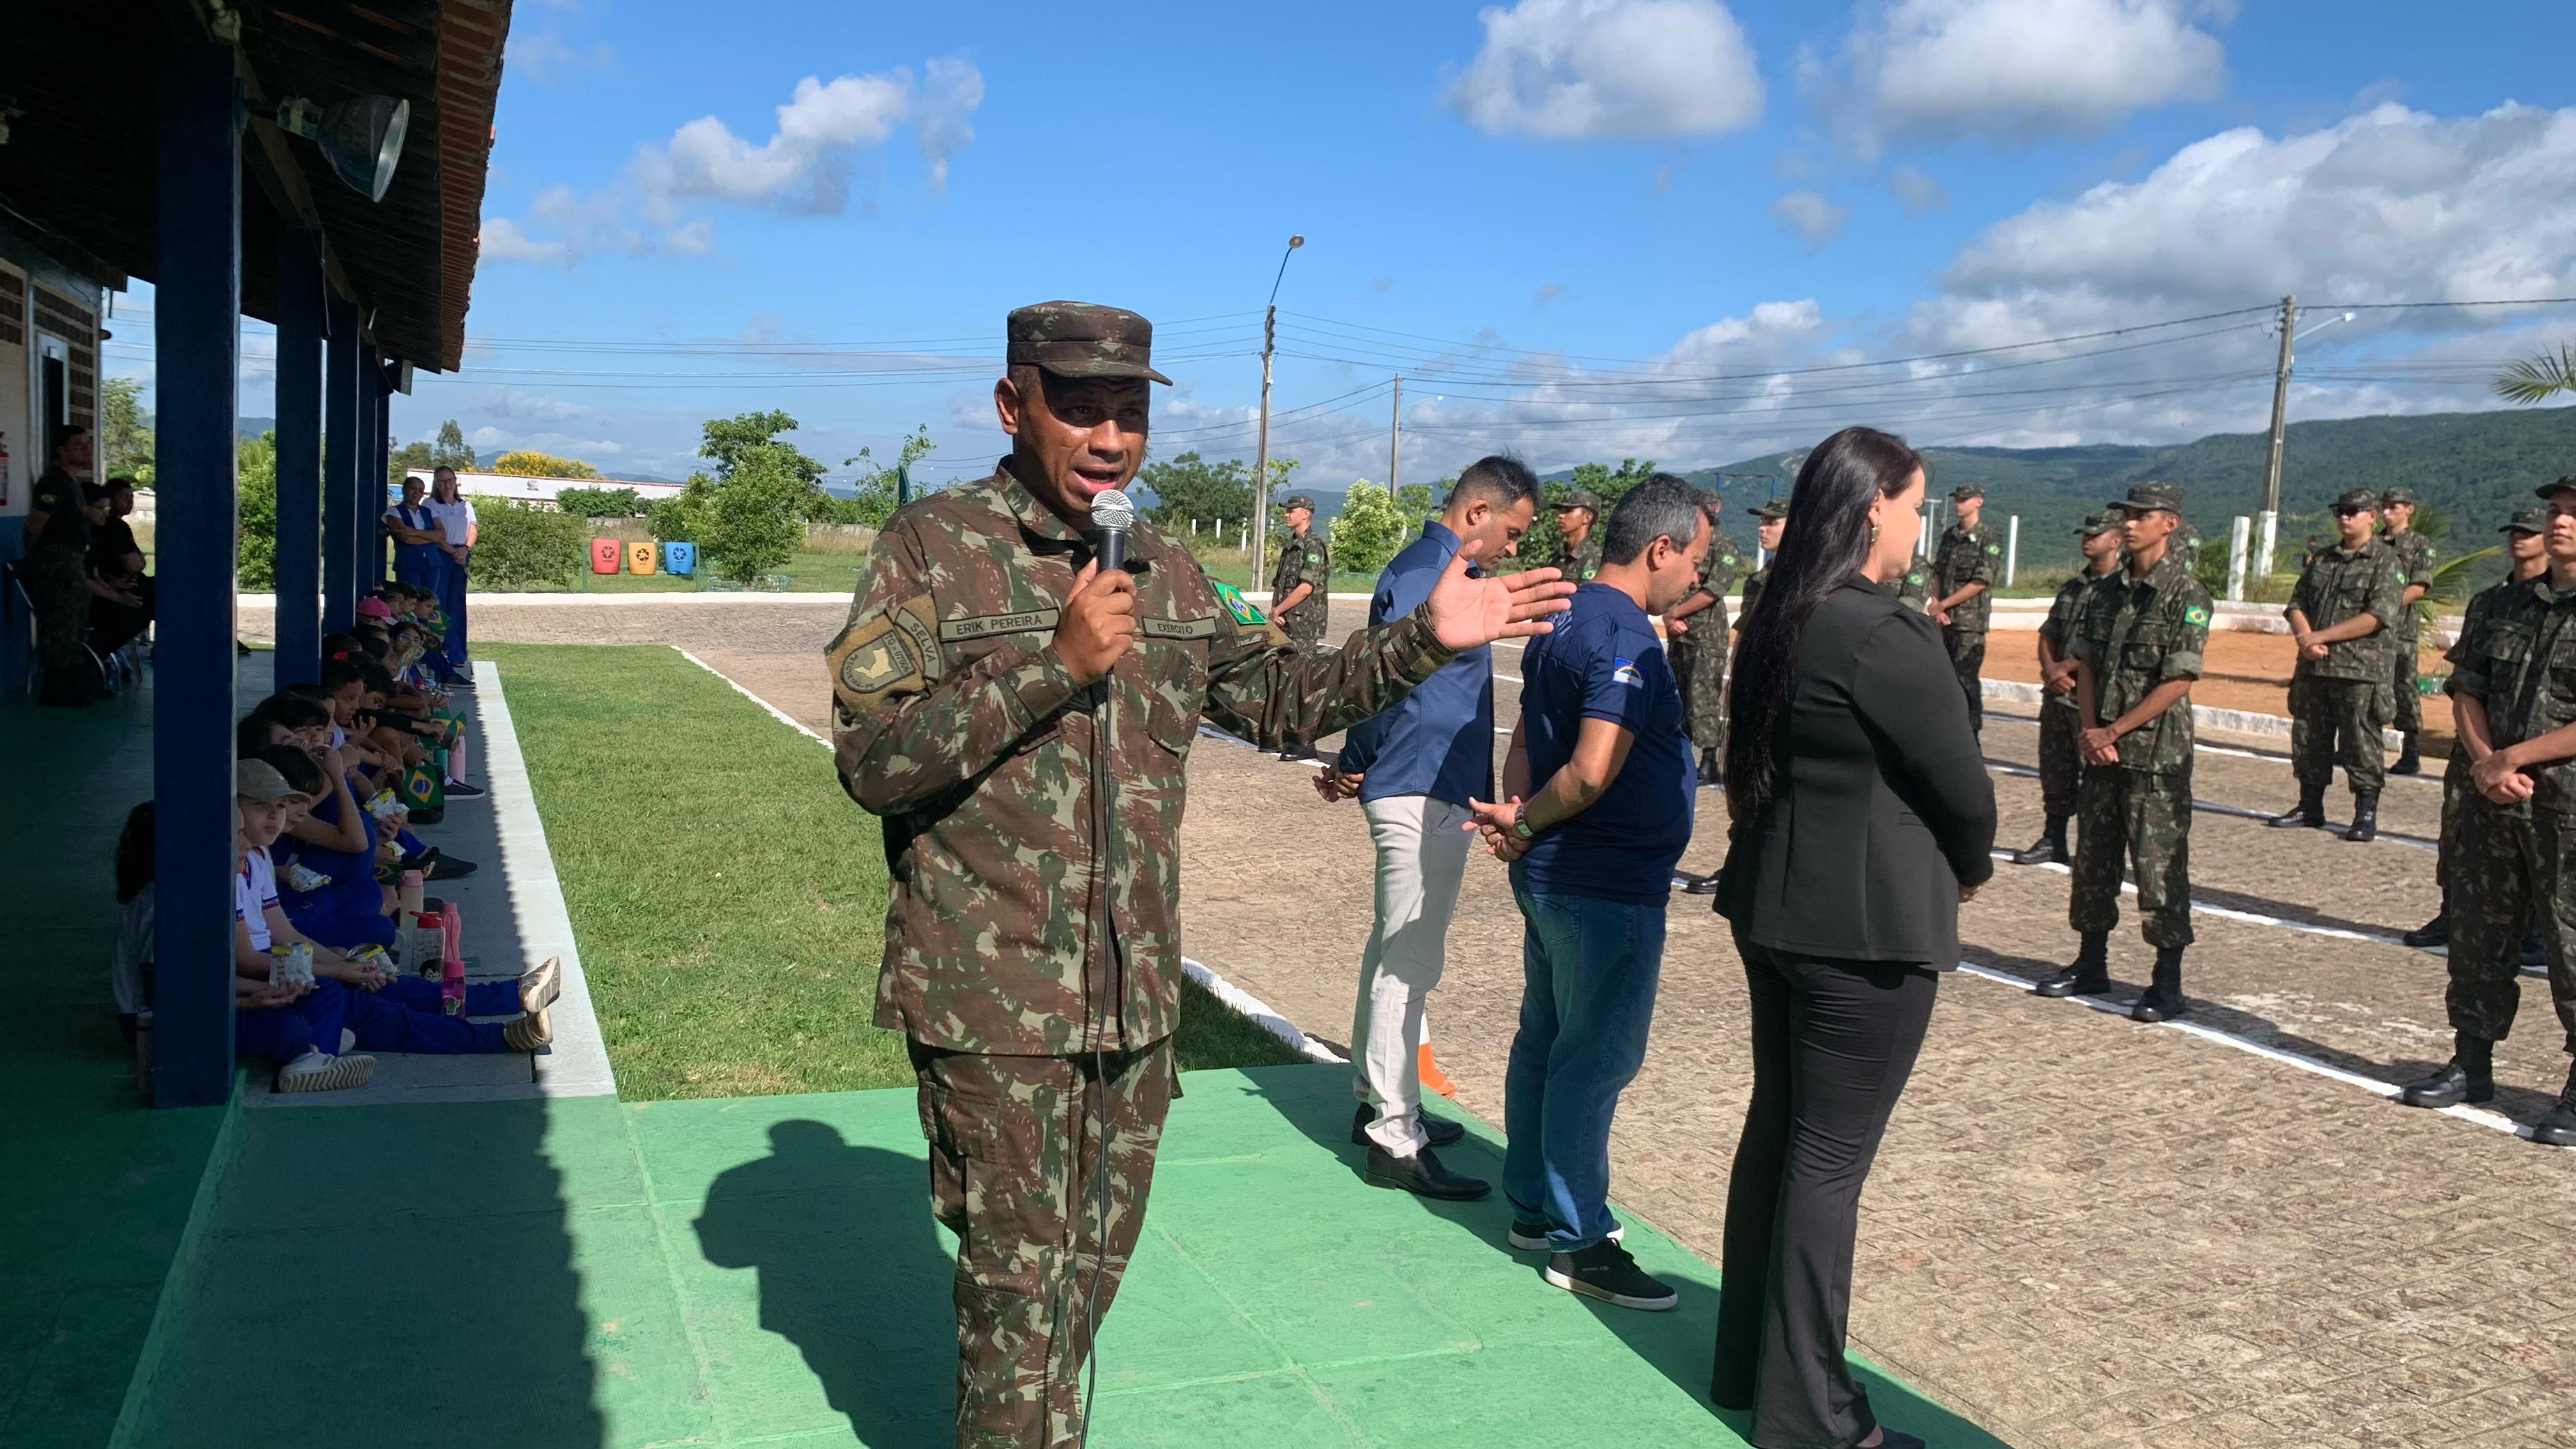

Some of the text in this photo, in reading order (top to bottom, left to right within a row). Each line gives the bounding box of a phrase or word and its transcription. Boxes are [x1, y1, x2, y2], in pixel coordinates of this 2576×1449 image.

[956, 615, 1043, 634] ERIK PEREIRA
[910, 622, 937, 663] SELVA
